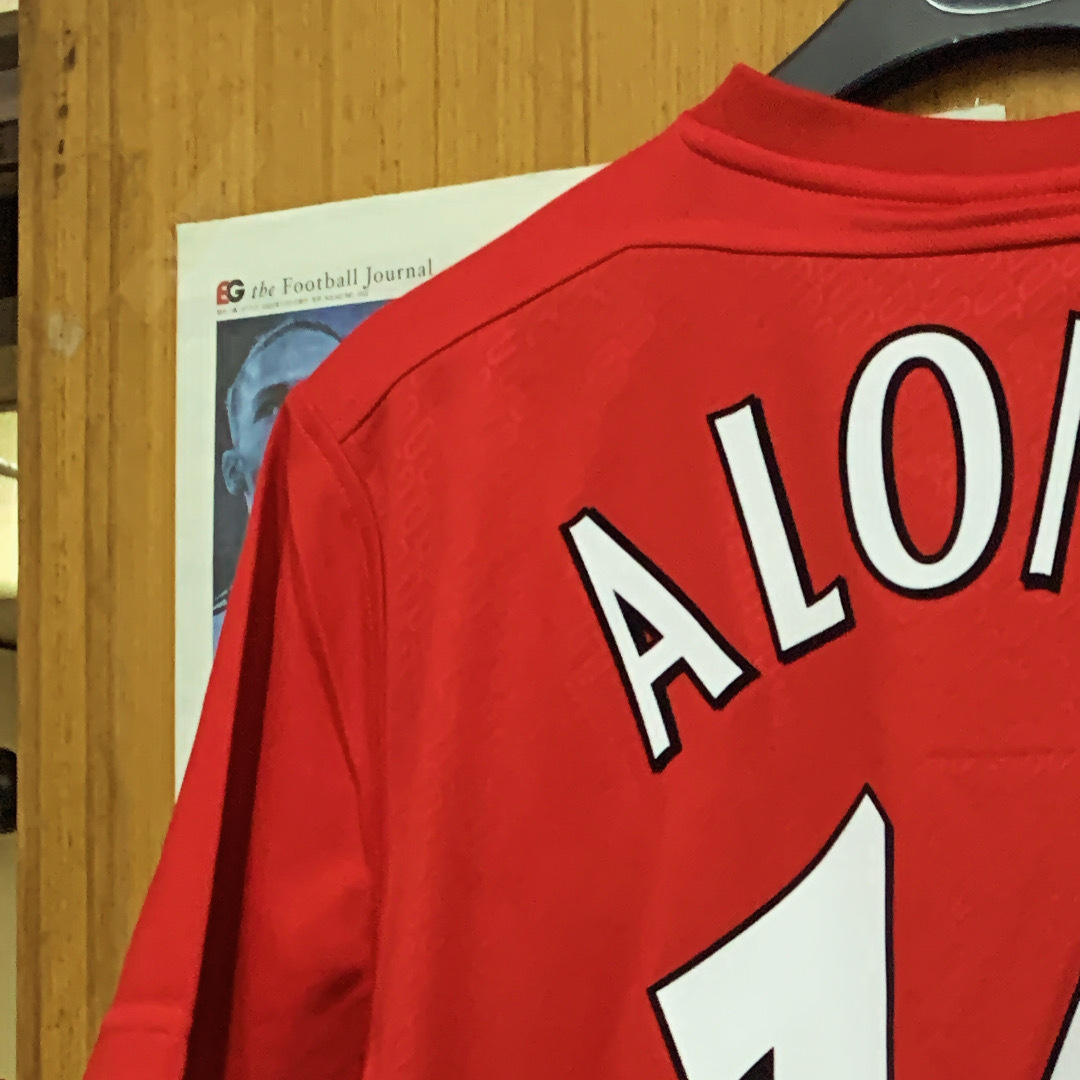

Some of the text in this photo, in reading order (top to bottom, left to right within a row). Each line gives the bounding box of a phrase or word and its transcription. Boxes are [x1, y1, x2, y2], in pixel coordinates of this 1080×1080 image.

[251, 280, 275, 299] the
[282, 267, 358, 295] Football
[363, 258, 433, 290] Journal
